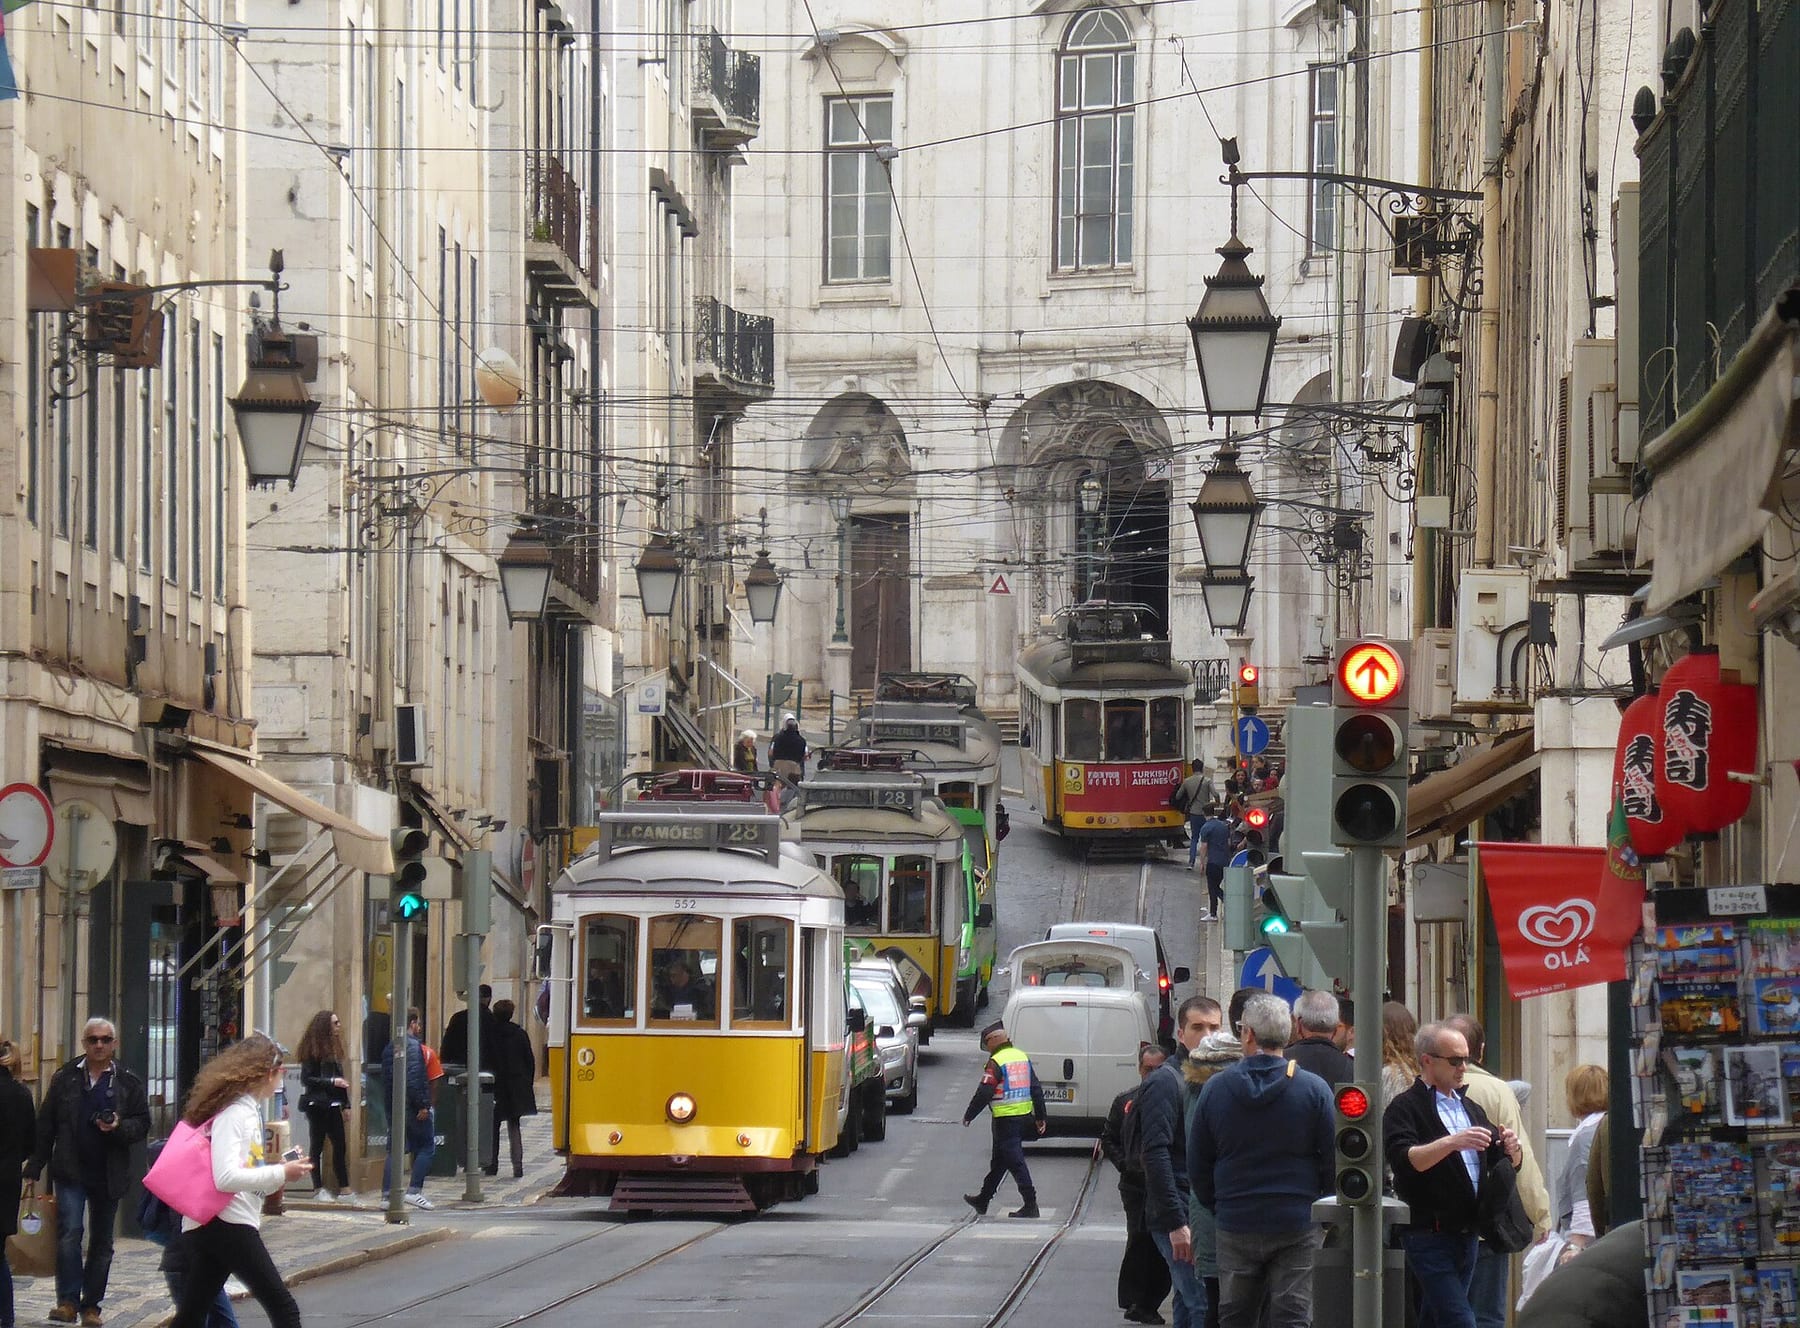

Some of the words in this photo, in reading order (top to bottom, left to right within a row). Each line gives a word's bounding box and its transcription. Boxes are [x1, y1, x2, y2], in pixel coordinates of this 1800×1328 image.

[933, 725, 952, 737] 28
[1131, 770, 1168, 778] TURKISH
[1131, 778, 1168, 786] AIRLINES
[884, 791, 906, 804] 28
[728, 824, 759, 841] 28
[674, 899, 696, 909] 552
[1544, 943, 1590, 970] OLÁ
[1677, 984, 1720, 992] LISBOA
